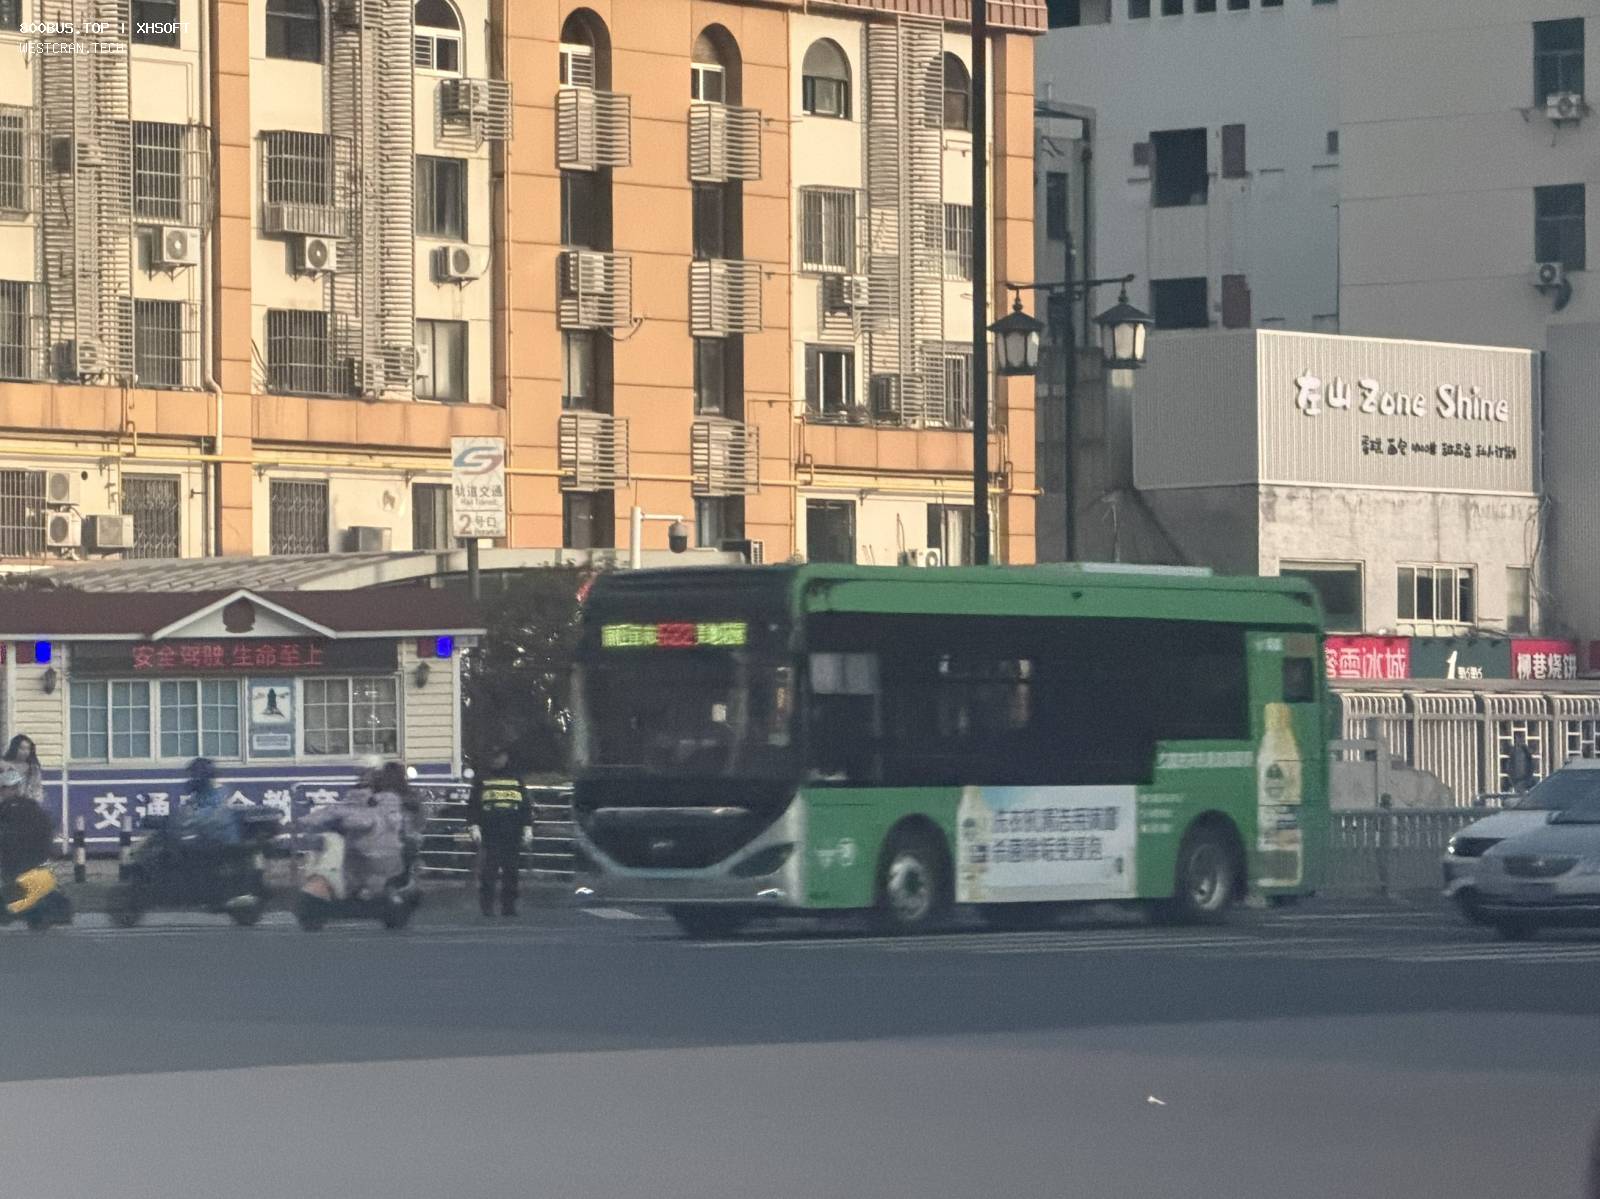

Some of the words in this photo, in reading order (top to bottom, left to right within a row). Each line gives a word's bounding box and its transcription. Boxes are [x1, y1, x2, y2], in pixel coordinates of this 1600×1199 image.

[1358, 378, 1427, 417] Zone
[1436, 383, 1510, 422] Shine
[232, 644, 323, 667] 生命至上
